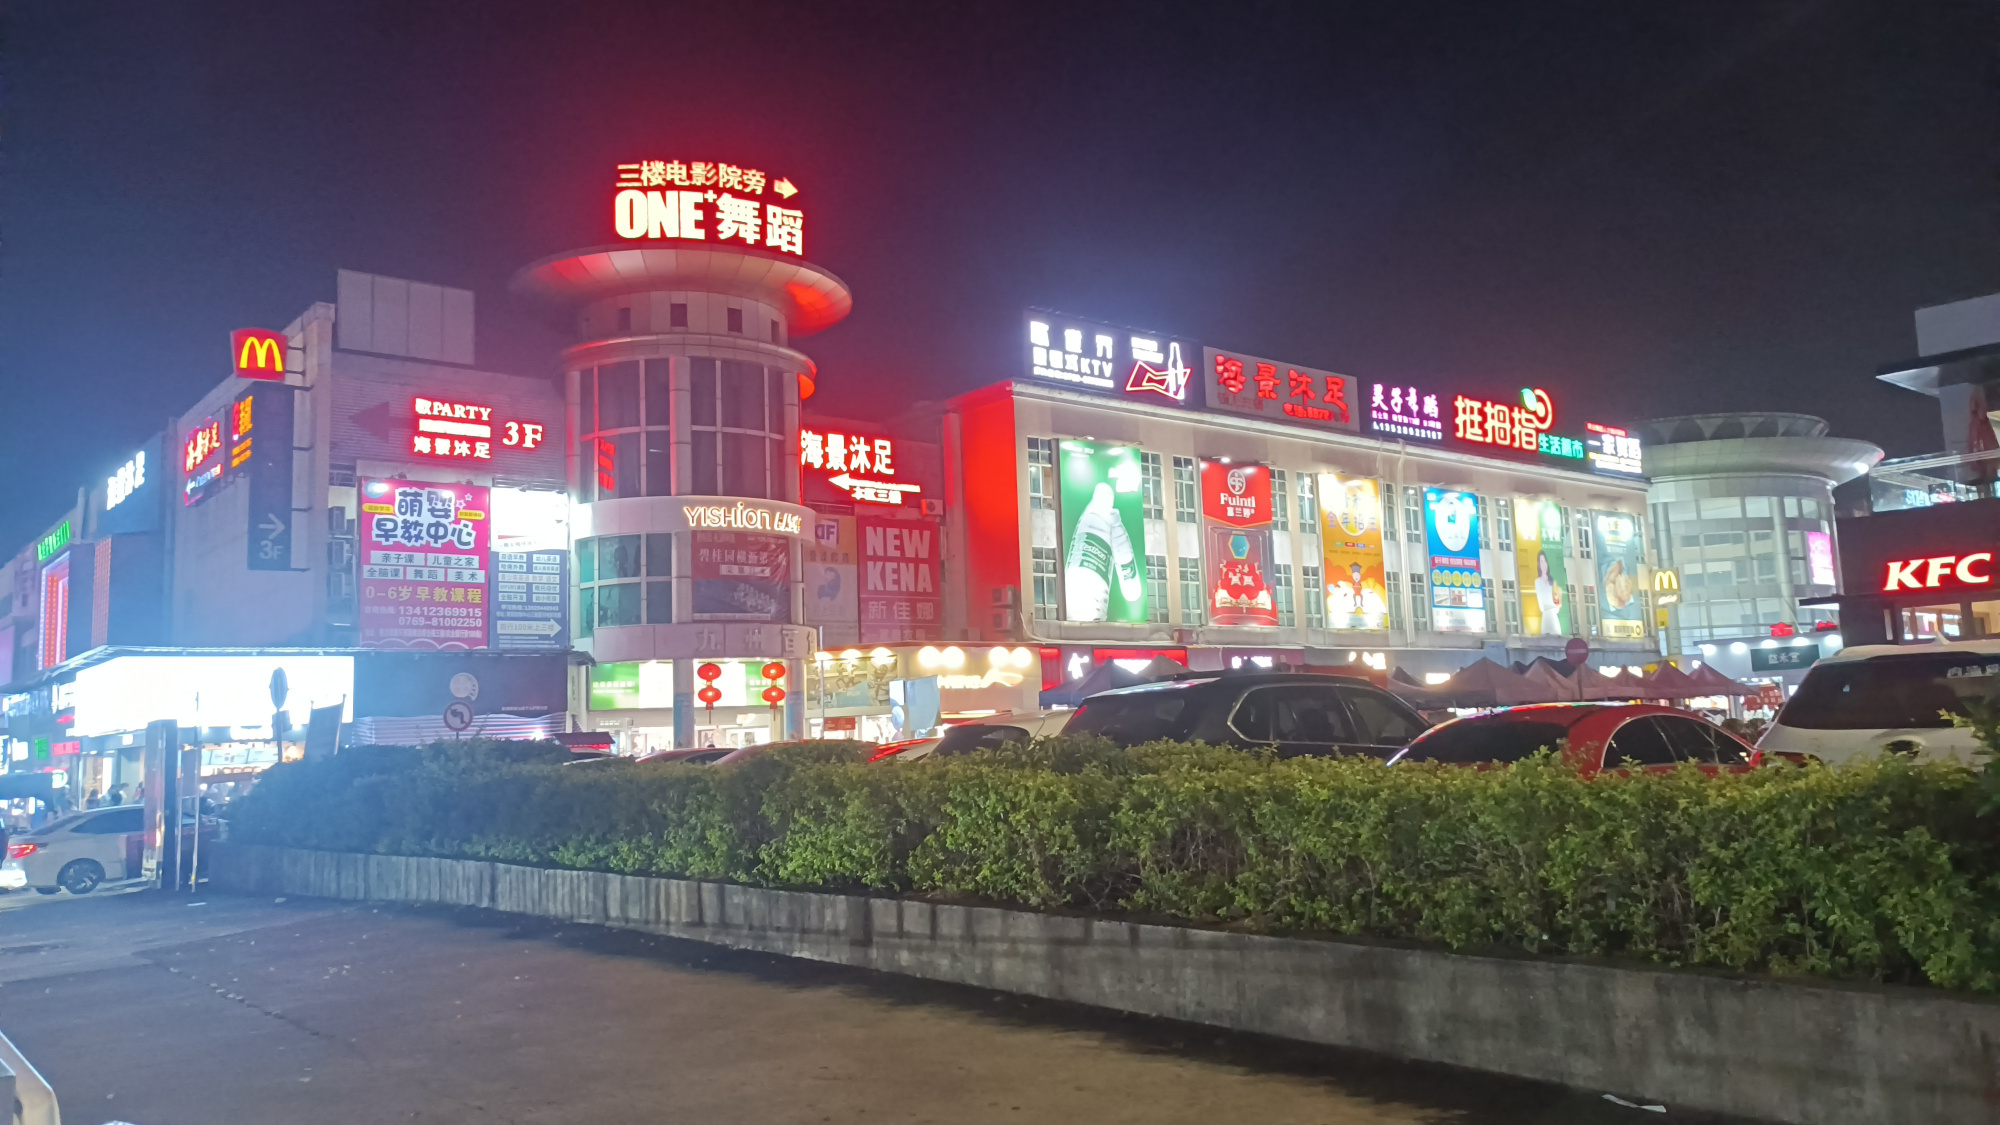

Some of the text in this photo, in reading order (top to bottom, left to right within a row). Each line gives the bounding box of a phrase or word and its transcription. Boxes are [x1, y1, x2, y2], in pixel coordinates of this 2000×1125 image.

[615, 159, 766, 195] 三楼电影院旁
[1214, 354, 1349, 412] 海景沐足
[502, 421, 543, 448] 3F
[800, 429, 895, 475] 海景沐足
[374, 517, 473, 547] 早教中心
[865, 526, 931, 559] NEW
[367, 567, 400, 578] 全脑课
[381, 553, 415, 564] 亲子课
[432, 556, 475, 567] 儿童之家
[1883, 552, 1992, 591] KFC
[413, 569, 438, 580] 舞蹈
[454, 571, 478, 581] 美术
[867, 561, 933, 592] KENA
[398, 606, 482, 617] 13412369915
